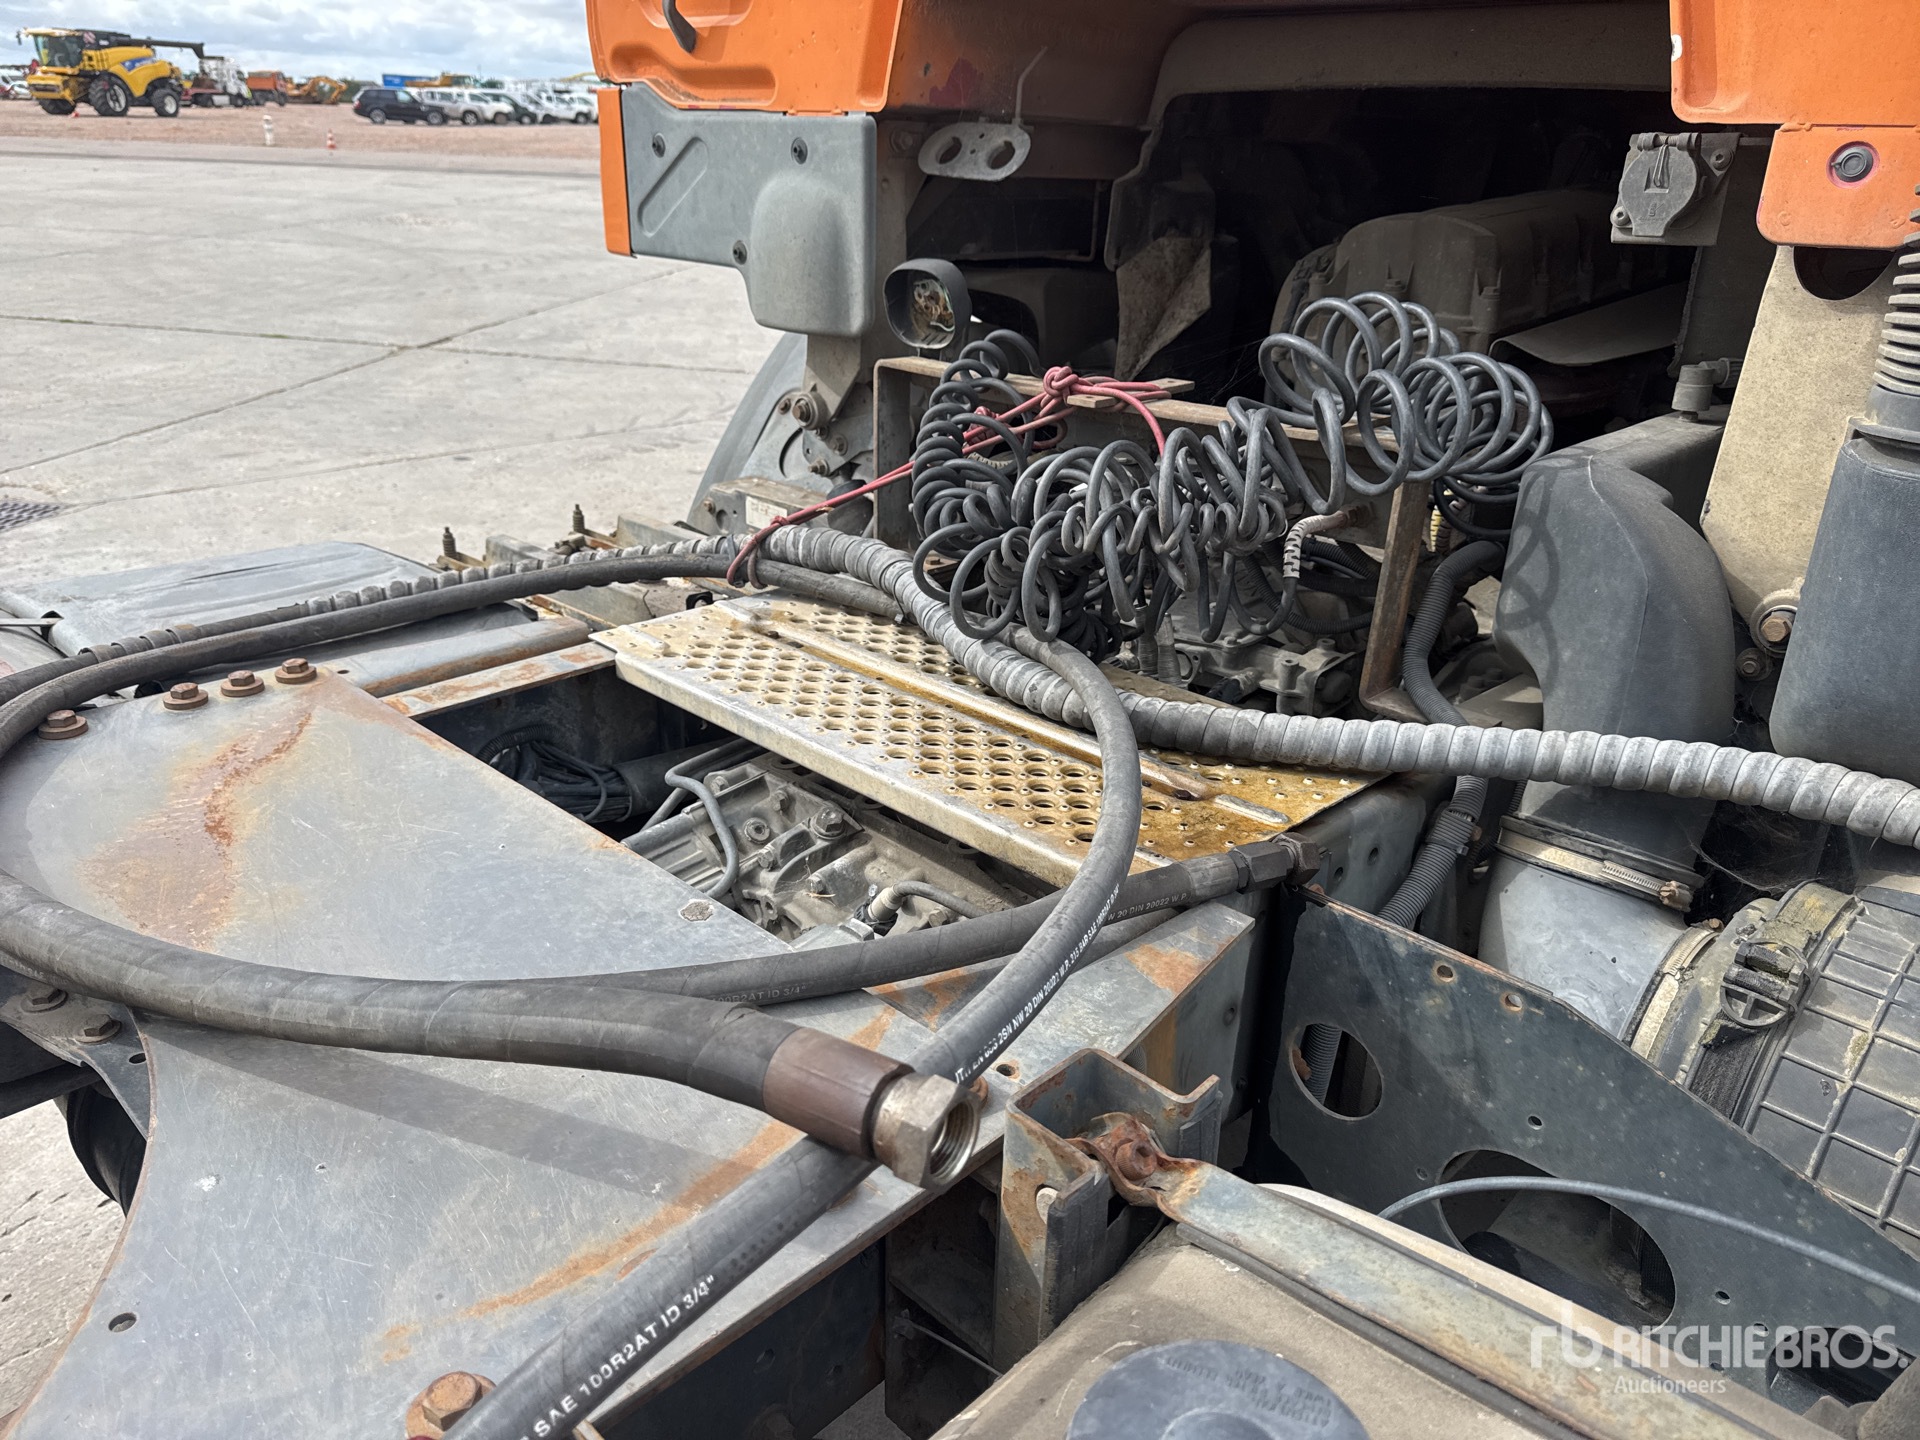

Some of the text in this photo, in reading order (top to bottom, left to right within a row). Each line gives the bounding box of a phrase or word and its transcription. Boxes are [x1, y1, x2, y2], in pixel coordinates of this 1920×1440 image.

[767, 989, 780, 998] ID
[783, 985, 807, 996] 3/4"
[1012, 1010, 1025, 1030] NW
[1024, 1002, 1033, 1018] 20
[1032, 989, 1044, 1008] DIN
[1079, 934, 1089, 953] BAR
[533, 1274, 716, 1438] SAE 100R2AT ID 3/4"
